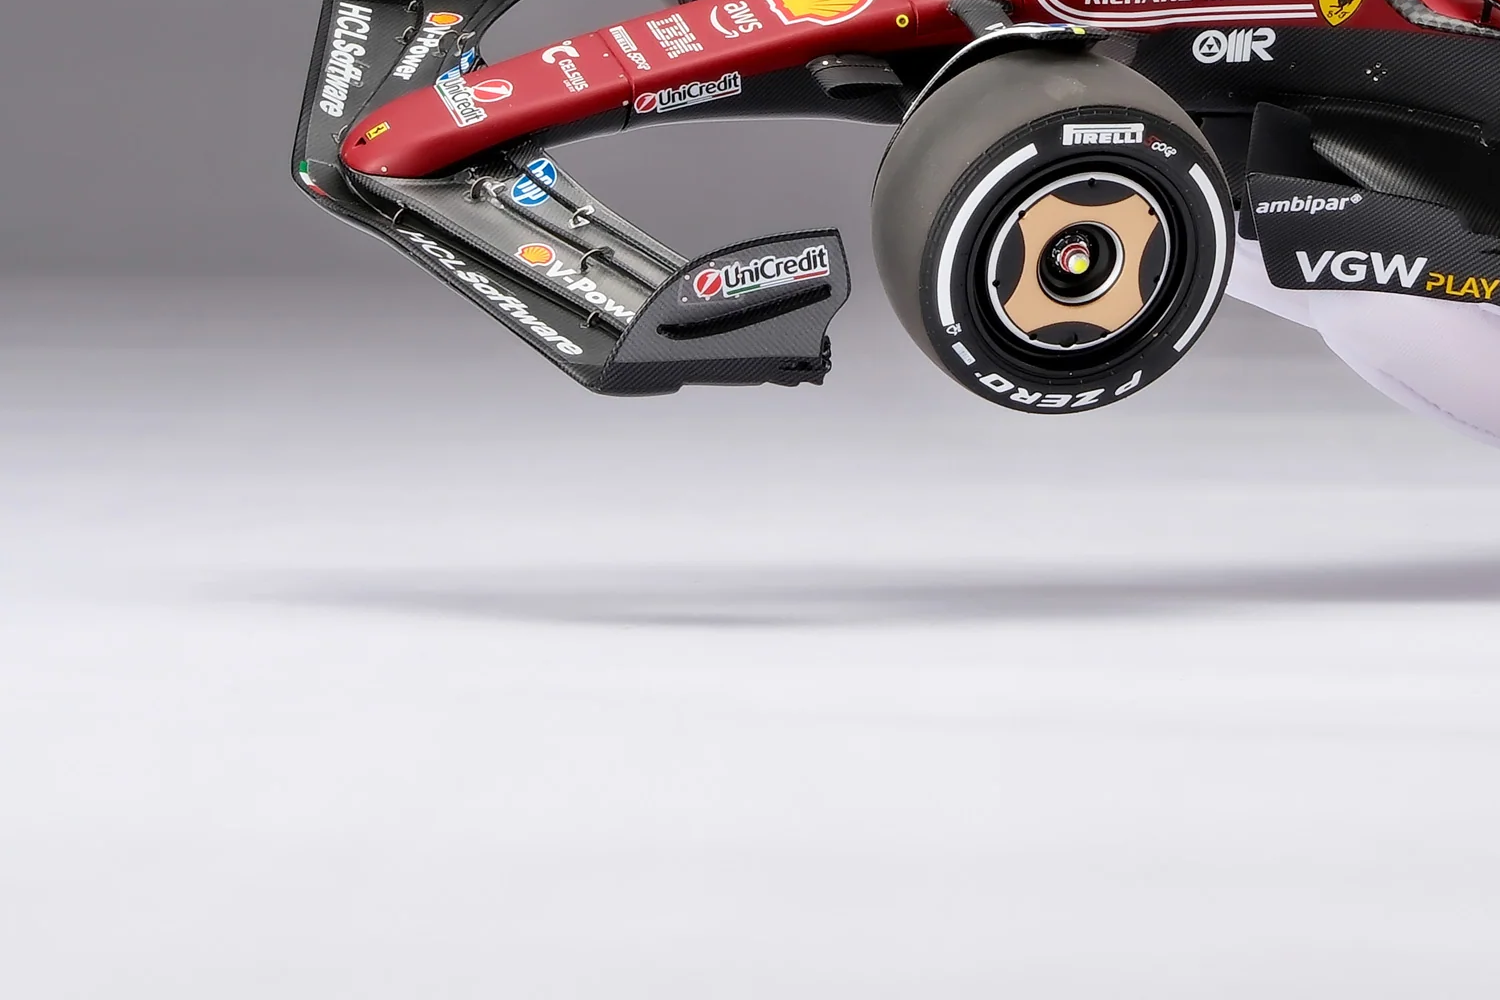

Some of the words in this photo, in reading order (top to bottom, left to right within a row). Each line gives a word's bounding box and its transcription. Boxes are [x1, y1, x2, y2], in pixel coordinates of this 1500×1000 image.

[723, 0, 763, 34] aws
[609, 25, 638, 54] PIRELLI
[646, 13, 704, 59] IBM
[558, 58, 589, 92] CELSIUS
[658, 73, 741, 107] UniCredit
[443, 76, 482, 123] UniCredit
[1062, 123, 1144, 146] PIRELLI
[1256, 194, 1350, 215] ambipar
[723, 246, 828, 290] UniCredit
[1296, 250, 1428, 288] VGW
[1425, 271, 1500, 300] PLAY
[545, 260, 636, 325] V-Pow
[978, 373, 1105, 408] ZERO
[1114, 369, 1142, 396] P
